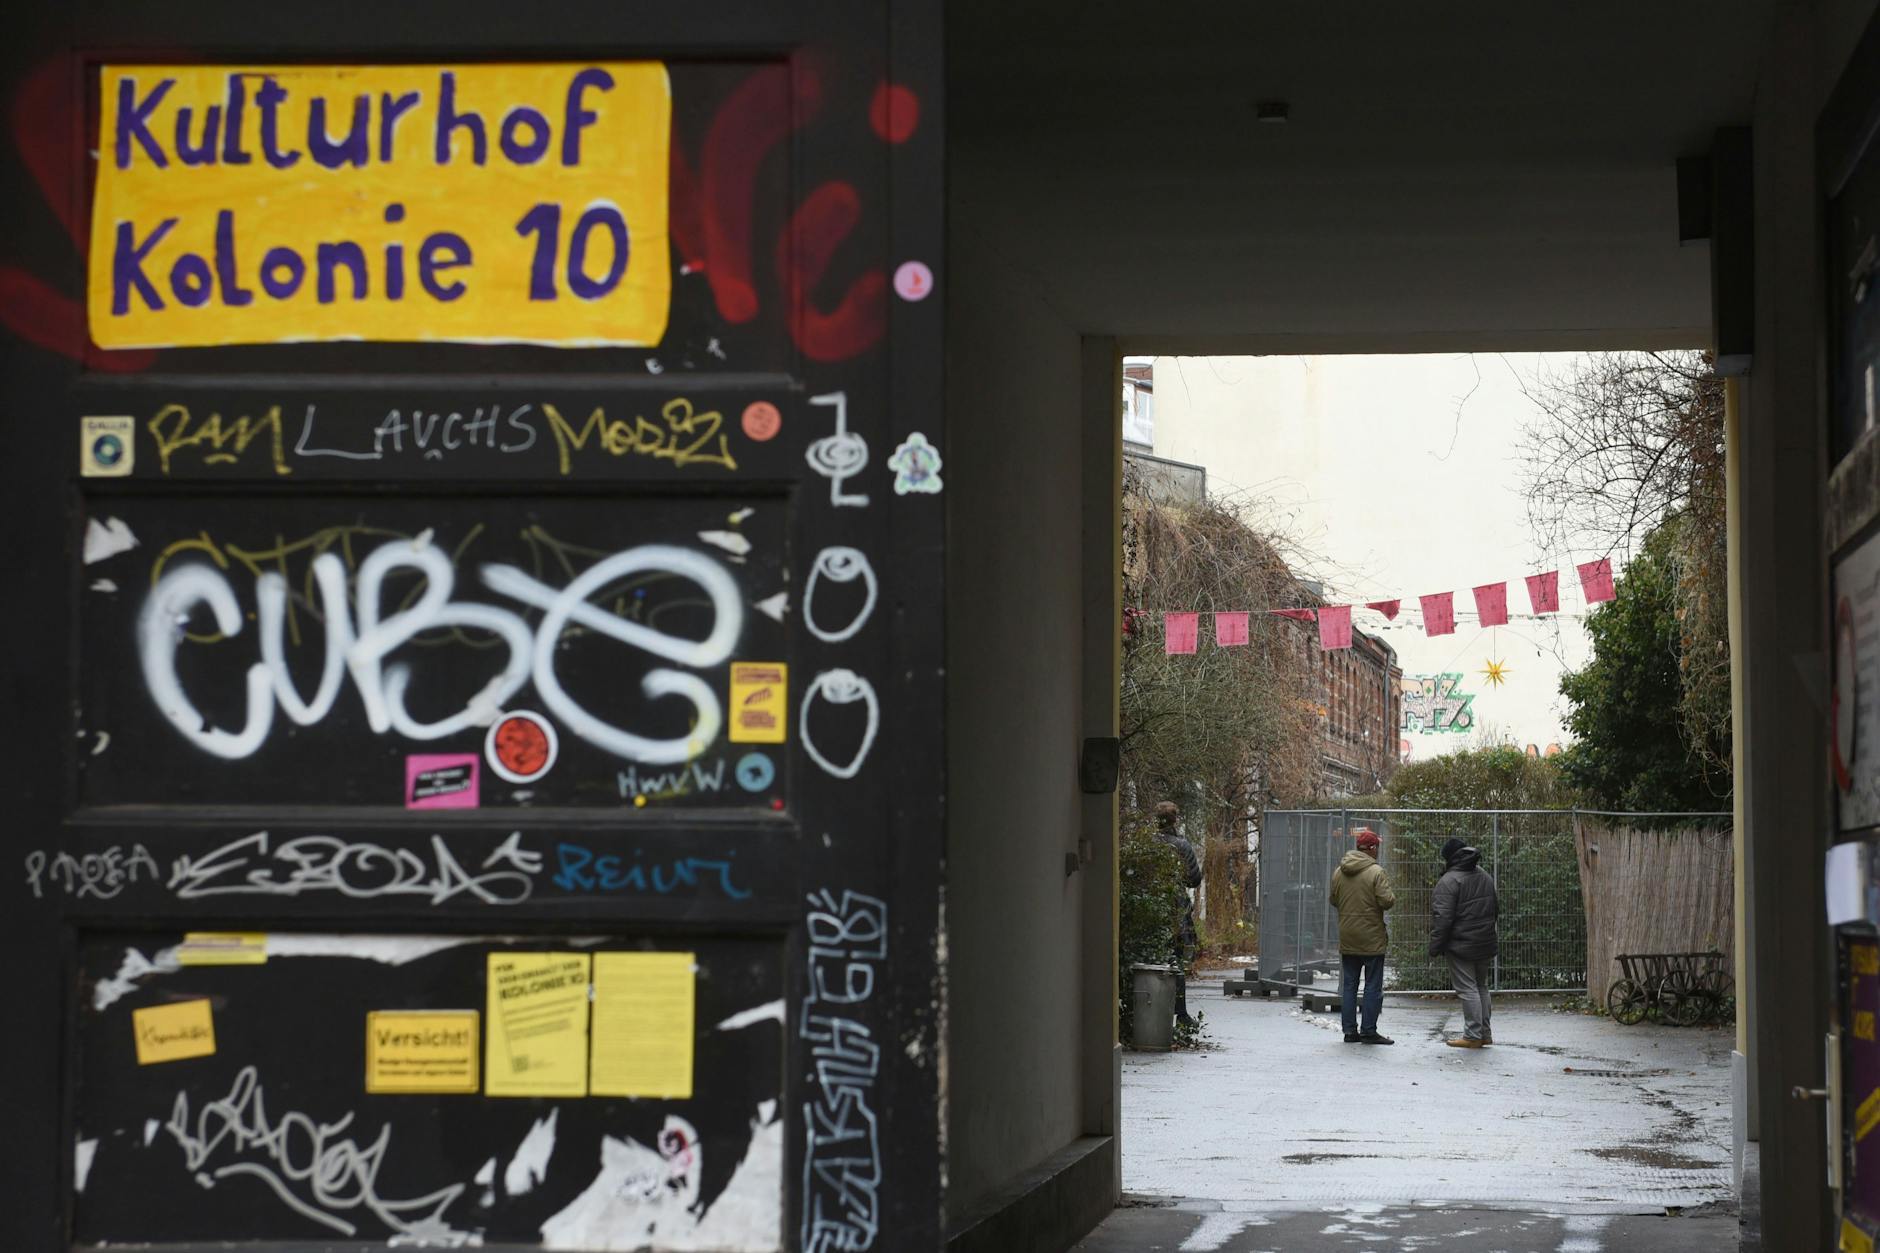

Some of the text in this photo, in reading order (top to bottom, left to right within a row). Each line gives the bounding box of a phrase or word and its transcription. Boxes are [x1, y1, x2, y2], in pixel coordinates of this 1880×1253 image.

[115, 68, 616, 170] Kulturhof
[110, 202, 630, 316] Kolonie 10
